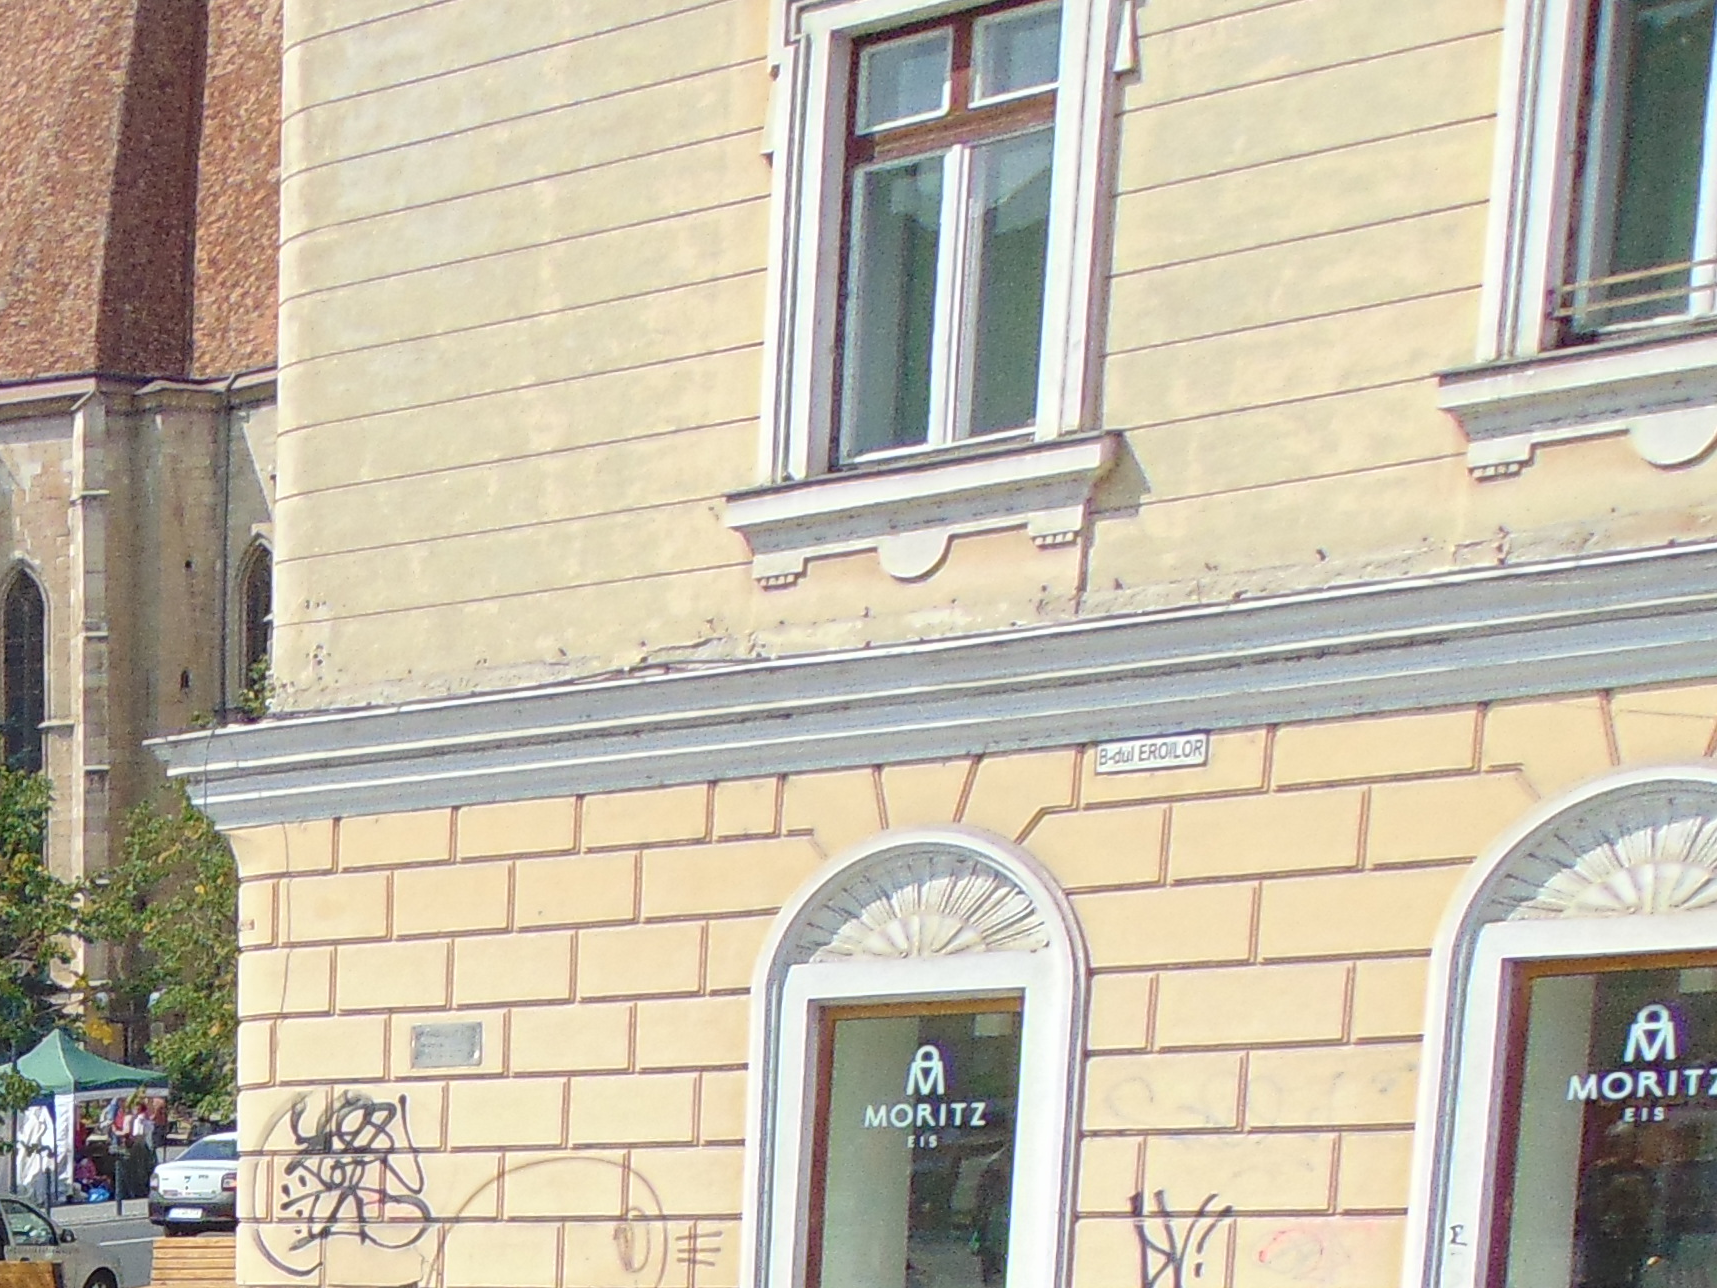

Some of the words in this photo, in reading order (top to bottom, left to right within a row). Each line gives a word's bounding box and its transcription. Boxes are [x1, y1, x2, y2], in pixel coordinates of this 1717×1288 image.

[1099, 746, 1134, 766] B-dul
[1138, 739, 1204, 762] EROILOR
[864, 1102, 986, 1128] MORITZ
[1623, 1106, 1665, 1122] EIS
[907, 1135, 938, 1148] EIS
